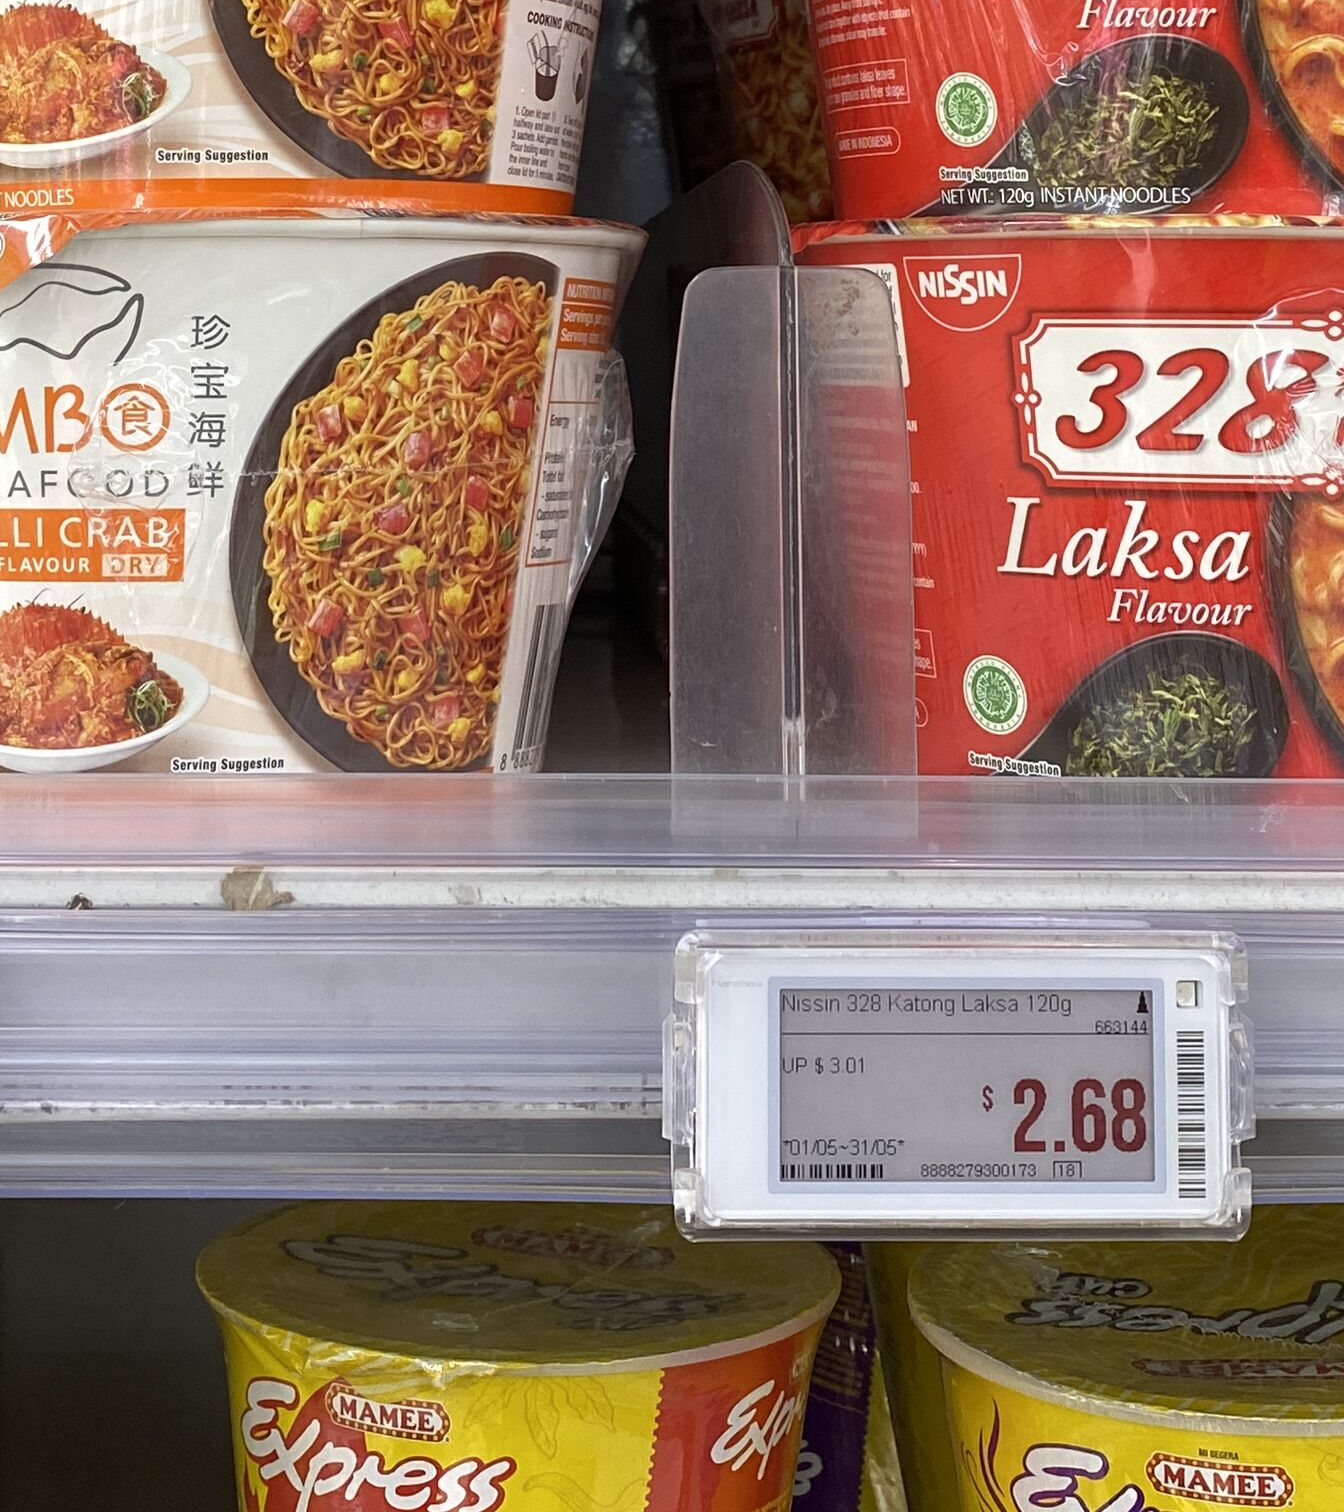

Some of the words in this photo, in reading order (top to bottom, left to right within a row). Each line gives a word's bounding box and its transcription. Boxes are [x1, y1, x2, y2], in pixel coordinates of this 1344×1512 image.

[157, 149, 202, 165] Serving
[205, 148, 269, 165] Suggestion
[974, 169, 1027, 182] Suggestion
[5, 188, 74, 207] NOODLES
[941, 188, 965, 204] NET
[999, 188, 1034, 207] 120g
[1041, 187, 1110, 203] INSTANT
[1111, 188, 1191, 204] NOODLES
[919, 265, 1008, 305] NISSIN
[187, 313, 231, 499] 珍宝海鲜
[1054, 348, 1329, 454] 328
[59, 515, 170, 549] CRAB
[997, 497, 1250, 583] Laksa
[110, 555, 160, 576] DRY
[1107, 589, 1253, 628] Flavour
[172, 758, 216, 773] Serving
[220, 757, 284, 773] Suggestion
[782, 994, 840, 1013] Nissin
[846, 994, 881, 1013] 328
[887, 994, 954, 1017] Katong
[962, 994, 1018, 1013] Laksa
[1026, 994, 1072, 1017] 120g
[1094, 1020, 1147, 1034] 663144
[782, 1057, 808, 1074] UP
[815, 1056, 824, 1076] $
[829, 1057, 865, 1074] 3.01
[982, 1085, 993, 1112] $
[1013, 1077, 1146, 1153] 2.68
[920, 1163, 1037, 1178] 8888279300173
[1058, 1164, 1075, 1178] 18
[337, 1393, 436, 1433] MAMEE
[246, 1378, 516, 1512] Express
[1162, 1466, 1276, 1500] MAMEE
